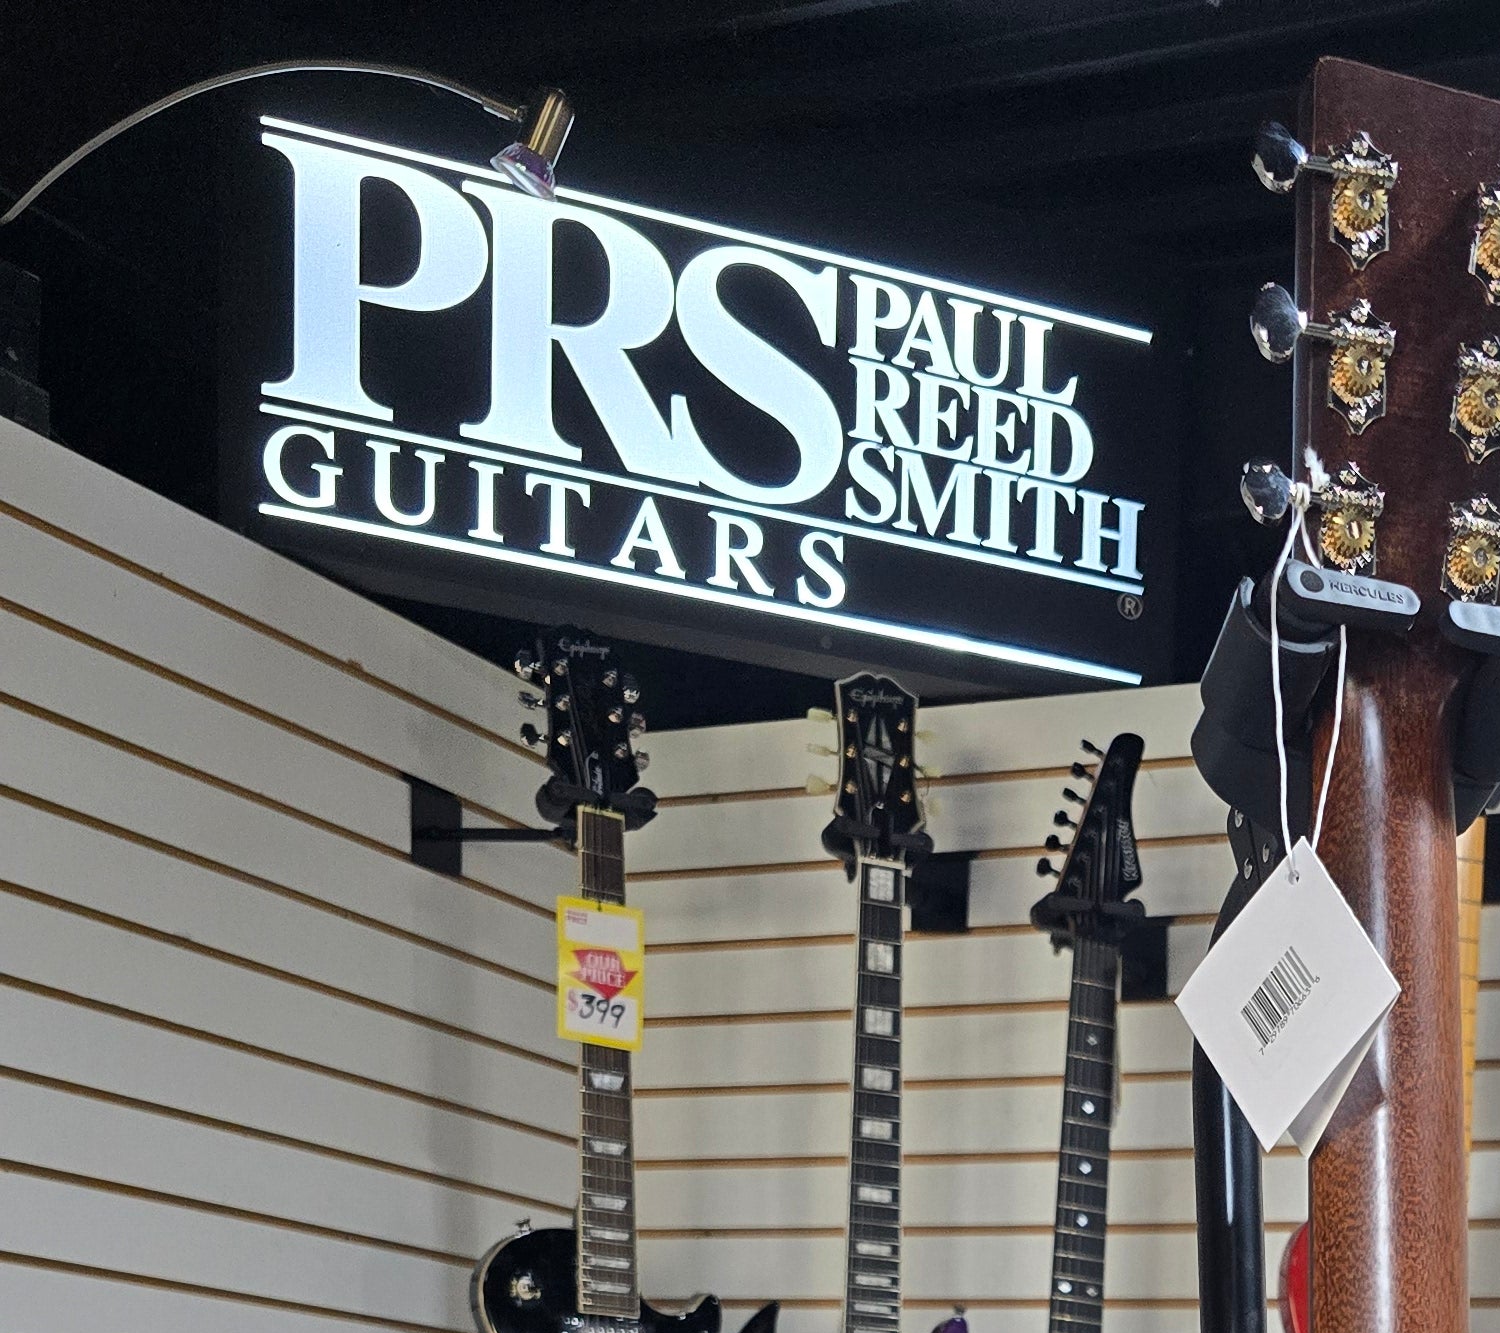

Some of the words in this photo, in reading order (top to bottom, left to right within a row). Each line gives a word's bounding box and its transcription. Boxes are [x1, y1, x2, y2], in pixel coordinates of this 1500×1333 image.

[261, 133, 844, 505] PRS
[850, 273, 1081, 406] PAUL
[850, 356, 1094, 485] REED
[263, 425, 848, 609] GUITARS
[847, 442, 1145, 581] SMITH
[1328, 579, 1405, 604] HERCULES
[567, 988, 626, 1029] $399
